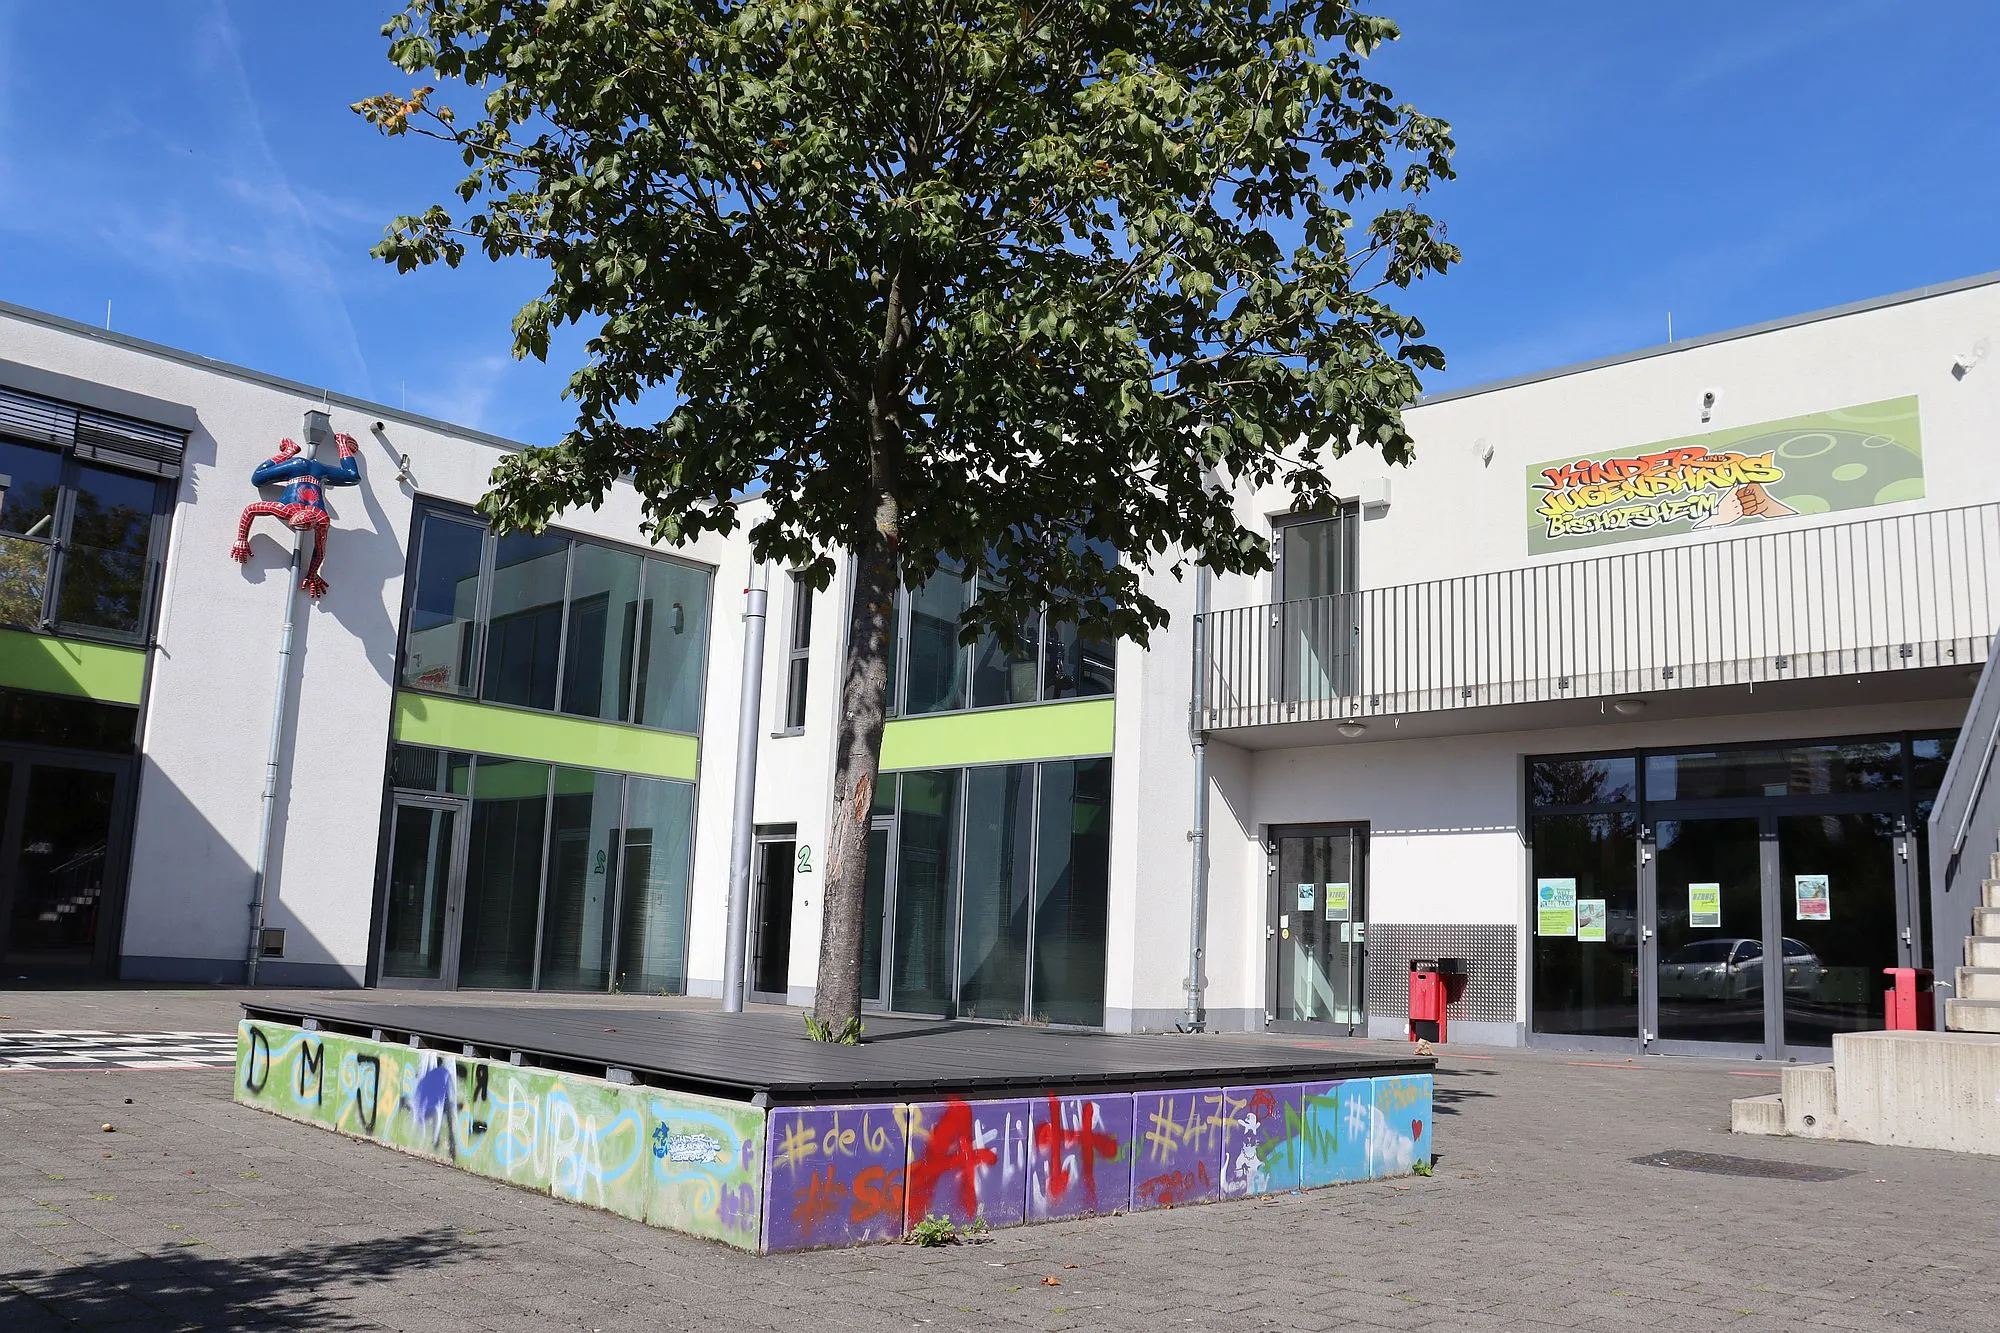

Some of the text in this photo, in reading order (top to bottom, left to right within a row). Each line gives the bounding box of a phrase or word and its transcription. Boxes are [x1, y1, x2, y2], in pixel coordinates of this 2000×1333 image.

[1702, 454, 1728, 462] UND
[1536, 451, 1783, 516] JUGENDHAUS
[797, 845, 812, 873] 2
